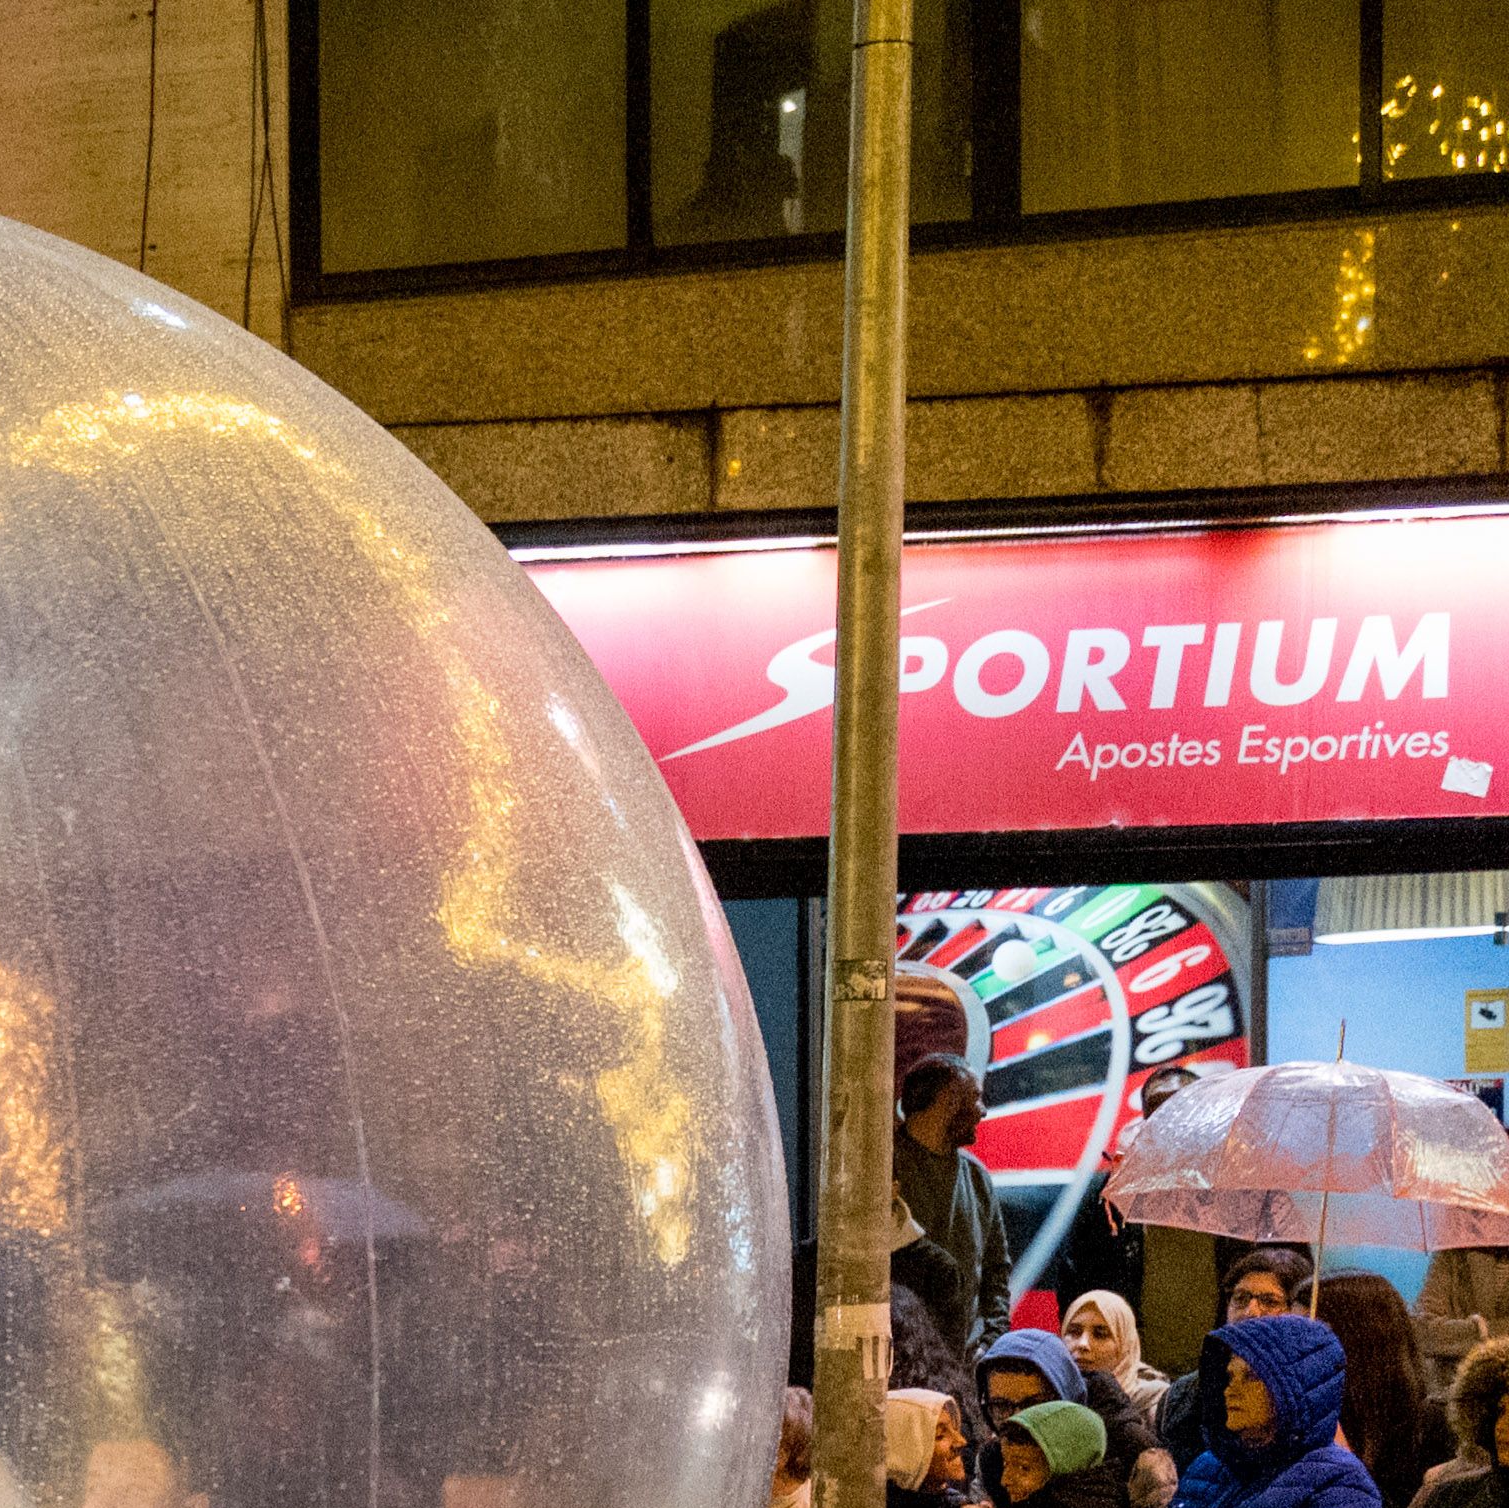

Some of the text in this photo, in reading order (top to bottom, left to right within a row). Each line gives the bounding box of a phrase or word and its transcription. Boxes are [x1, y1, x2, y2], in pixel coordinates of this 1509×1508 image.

[658, 598, 1450, 762] SPORTIUM
[1056, 721, 1449, 781] Apostes Esportives
[1100, 904, 1187, 962] 28
[1134, 983, 1234, 1064] 26
